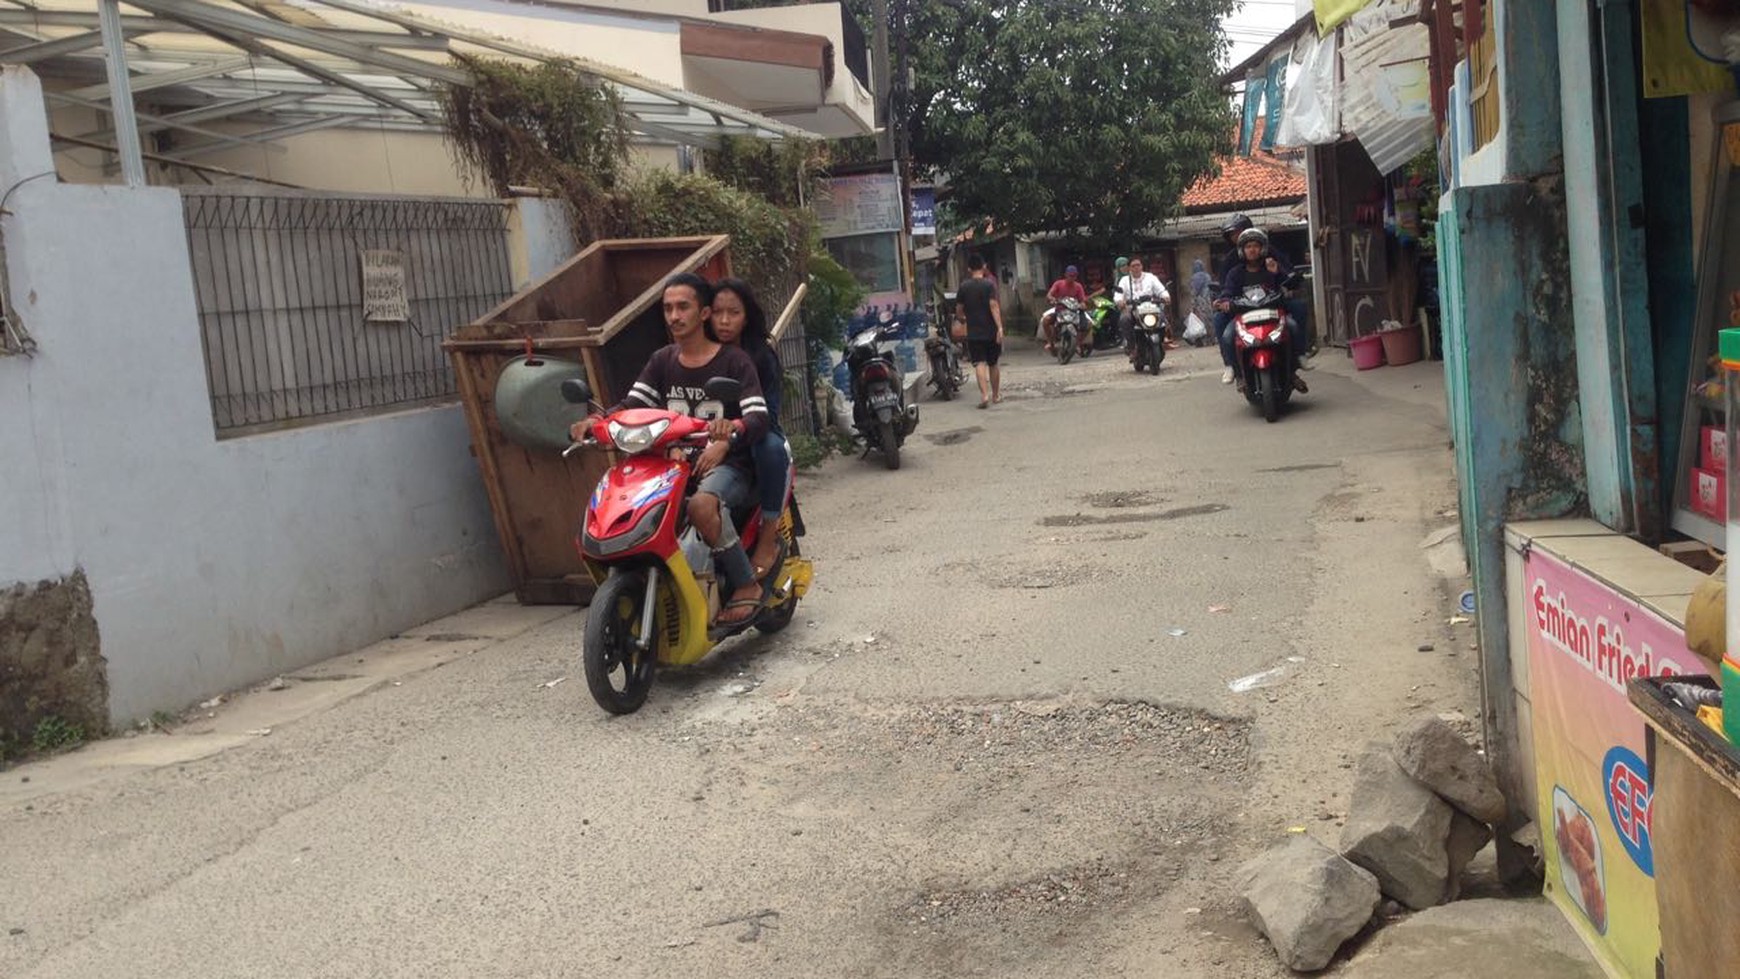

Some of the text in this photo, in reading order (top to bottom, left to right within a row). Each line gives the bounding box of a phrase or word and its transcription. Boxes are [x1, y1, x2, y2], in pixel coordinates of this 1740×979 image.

[666, 385, 685, 399] AS
[1533, 582, 1592, 667] Emian
[1610, 761, 1653, 847] EF
